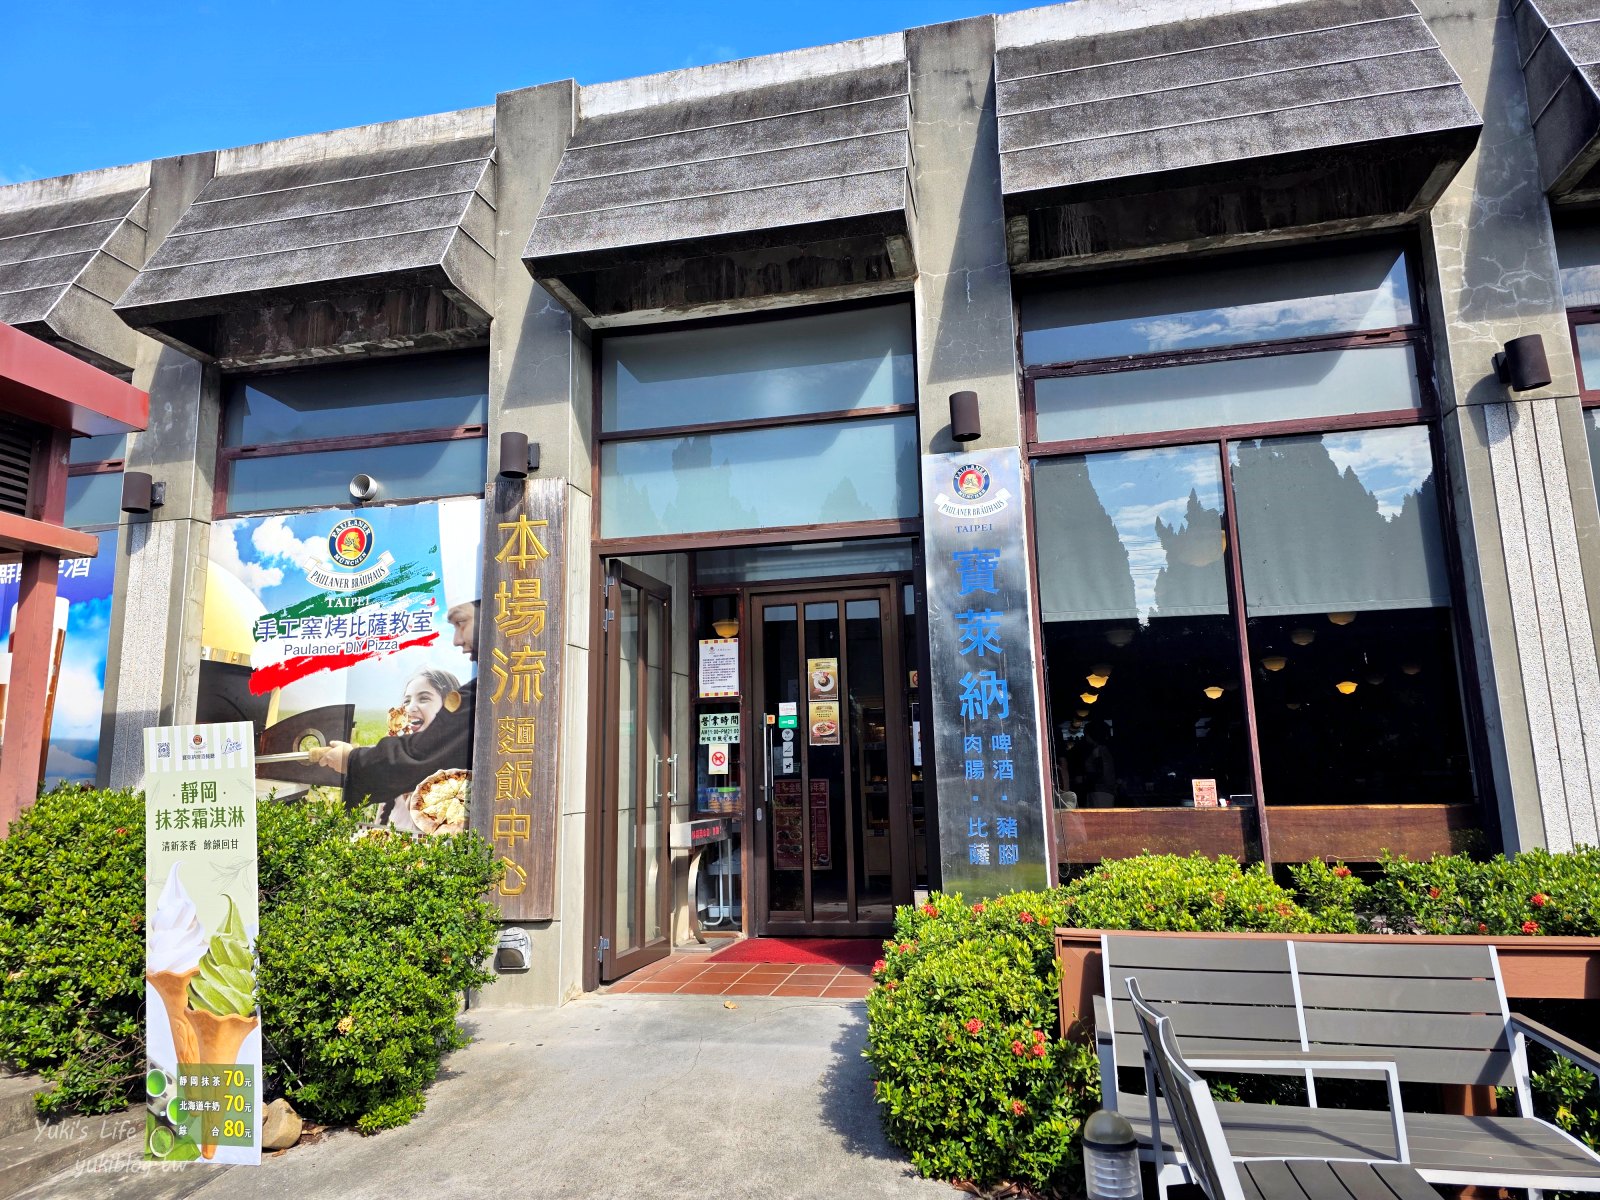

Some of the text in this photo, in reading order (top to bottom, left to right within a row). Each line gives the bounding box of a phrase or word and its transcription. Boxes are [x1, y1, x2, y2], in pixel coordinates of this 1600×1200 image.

[954, 464, 988, 480] PAULANER
[942, 499, 1005, 516] PAULANER BRÄUHAUS
[331, 518, 371, 538] PAULANER
[955, 523, 992, 534] TAIPEI
[333, 552, 367, 567] MÜNCHEN
[310, 565, 387, 589] PAULANER BRÄUHAUS
[325, 595, 370, 608] TAIPEI
[256, 610, 433, 643] 手工窯烤比薩教室
[952, 547, 1010, 720] 寶萊納
[284, 639, 398, 656] Paulaner DIY Pizza
[701, 715, 739, 727] 營業時間
[155, 806, 245, 830] 抹茶霜淇淋
[161, 838, 239, 852] 清新茶香 餘韻回甘
[179, 1101, 221, 1112] 北海道牛奶
